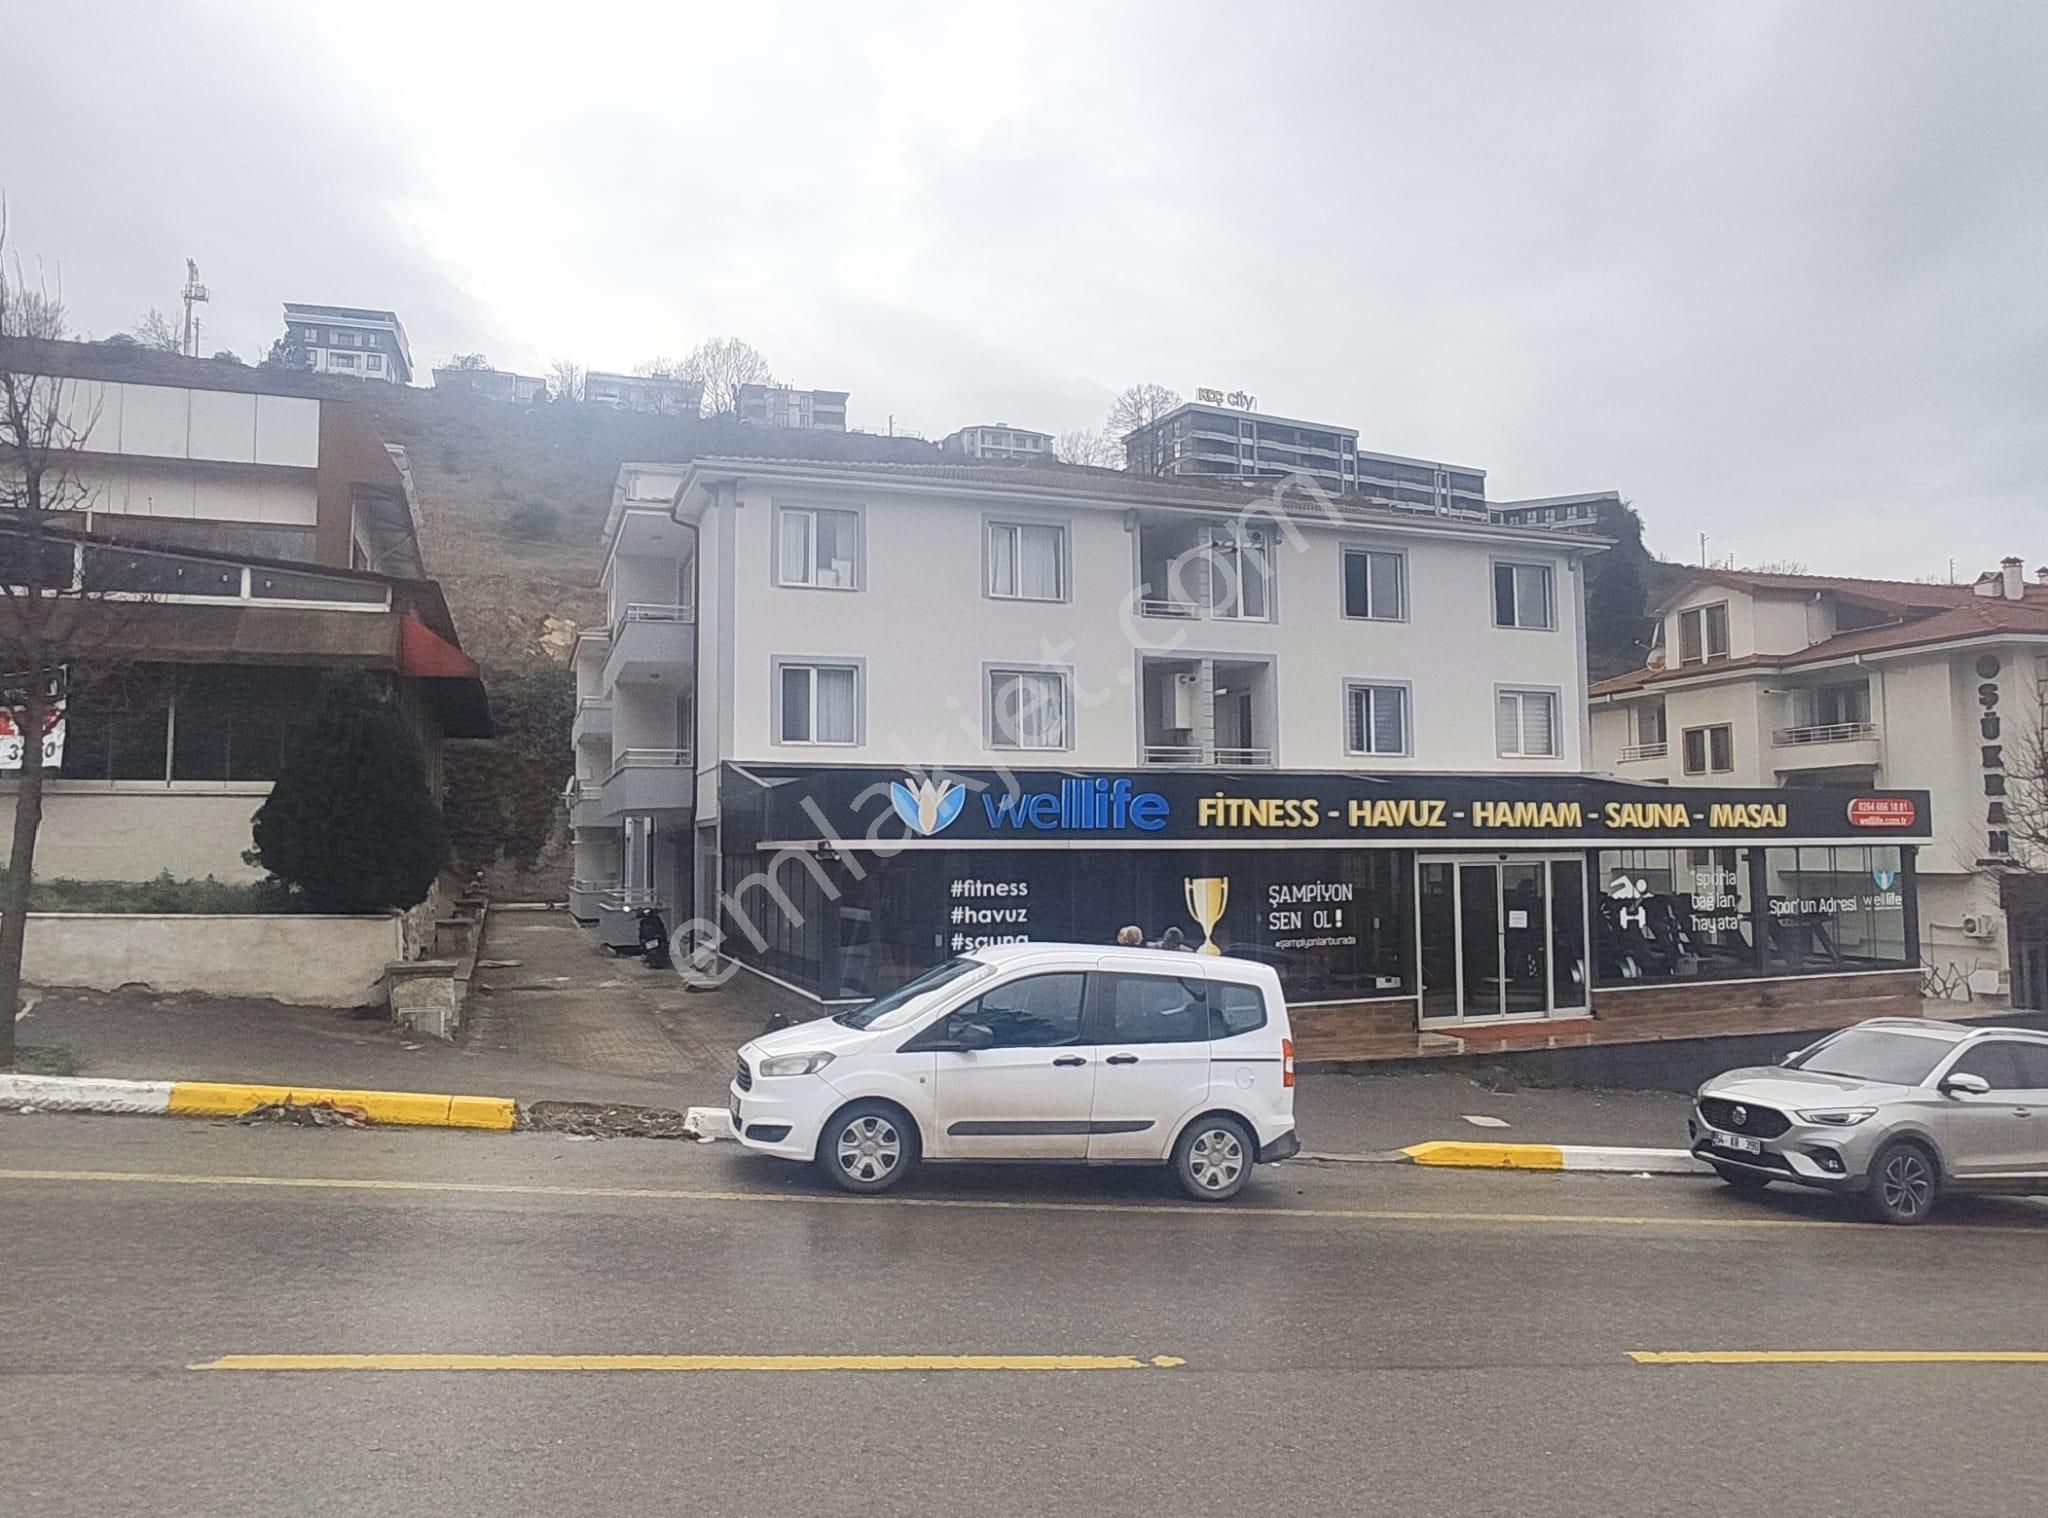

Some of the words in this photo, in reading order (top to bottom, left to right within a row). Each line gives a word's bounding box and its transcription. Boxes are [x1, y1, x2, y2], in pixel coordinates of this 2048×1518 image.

[1198, 791, 1320, 828] FİTNESS
[1349, 799, 1447, 828] HAVUZ
[1472, 801, 1583, 828] HAMAM
[1604, 802, 1691, 829] SAUNA
[1709, 803, 1787, 829] MASAJ
[950, 879, 1029, 898] #fitness
[1268, 880, 1353, 909] ŞAMPİYON
[950, 906, 1028, 925] #havuz
[1268, 911, 1303, 930] SEN
[950, 932, 1029, 951] #sauna
